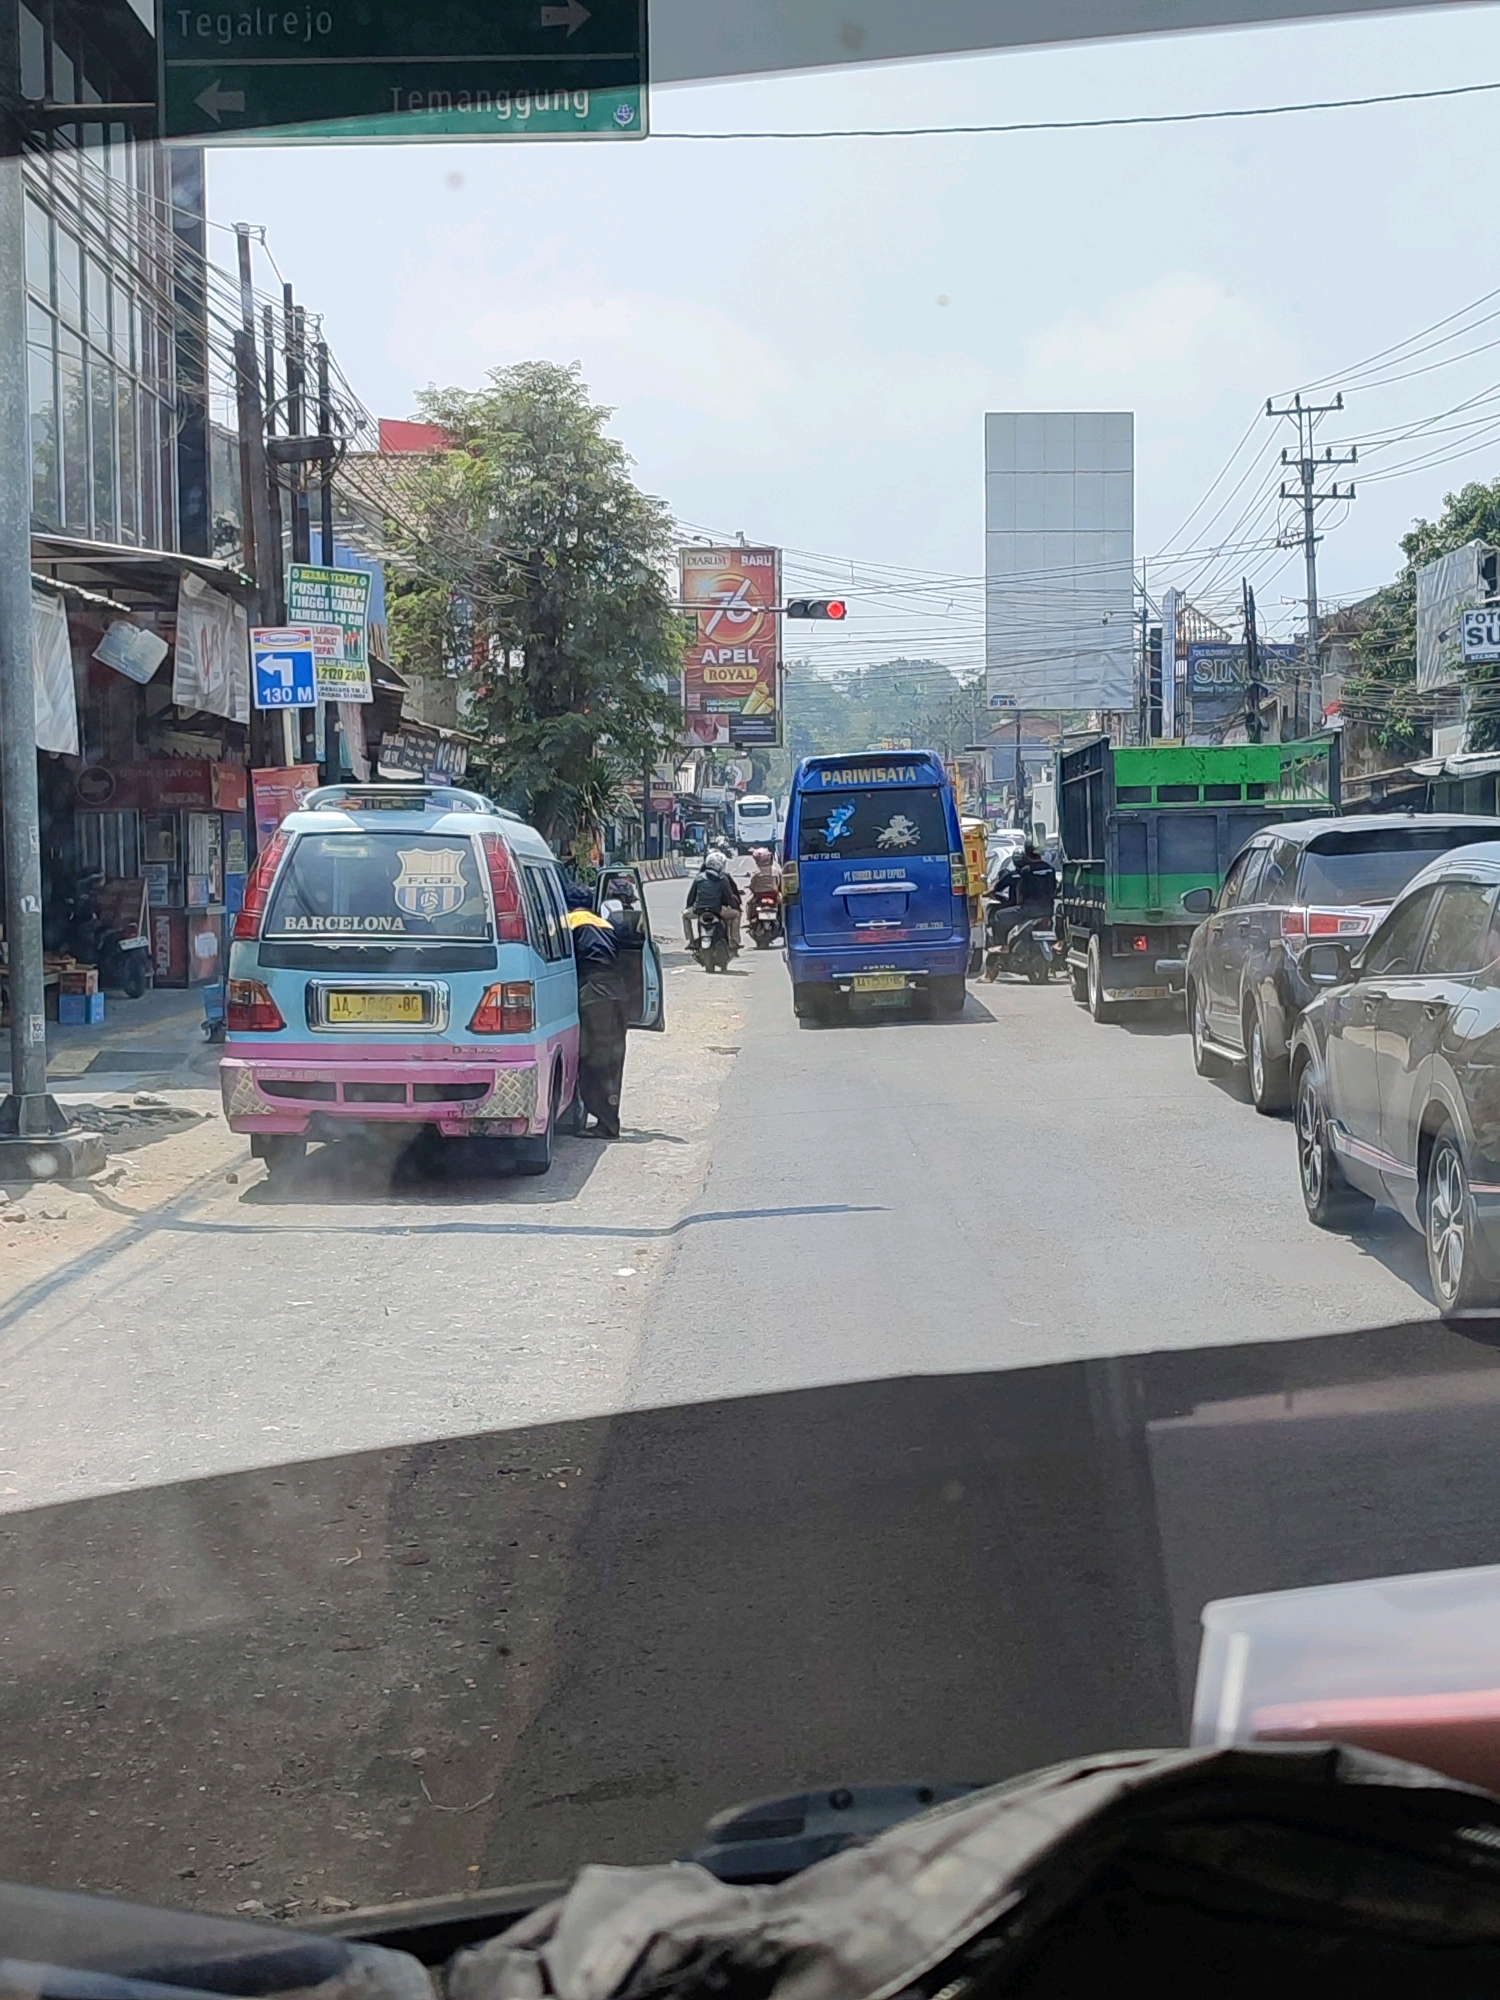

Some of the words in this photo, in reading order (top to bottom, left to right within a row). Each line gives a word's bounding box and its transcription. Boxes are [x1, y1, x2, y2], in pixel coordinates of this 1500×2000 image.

[177, 5, 333, 44] Tegalrejo
[390, 87, 590, 119] Temanggung
[741, 555, 772, 567] BARU
[291, 582, 327, 597] PUSAT
[330, 585, 366, 601] TERAPI
[705, 578, 752, 636] 76
[1465, 612, 1500, 625] FOT
[702, 649, 760, 664] APEL
[709, 668, 754, 681] ROYAL
[262, 687, 293, 703] 130
[297, 686, 313, 702] M
[821, 766, 917, 786] PARIWISATA
[284, 916, 406, 931] BARCELONA
